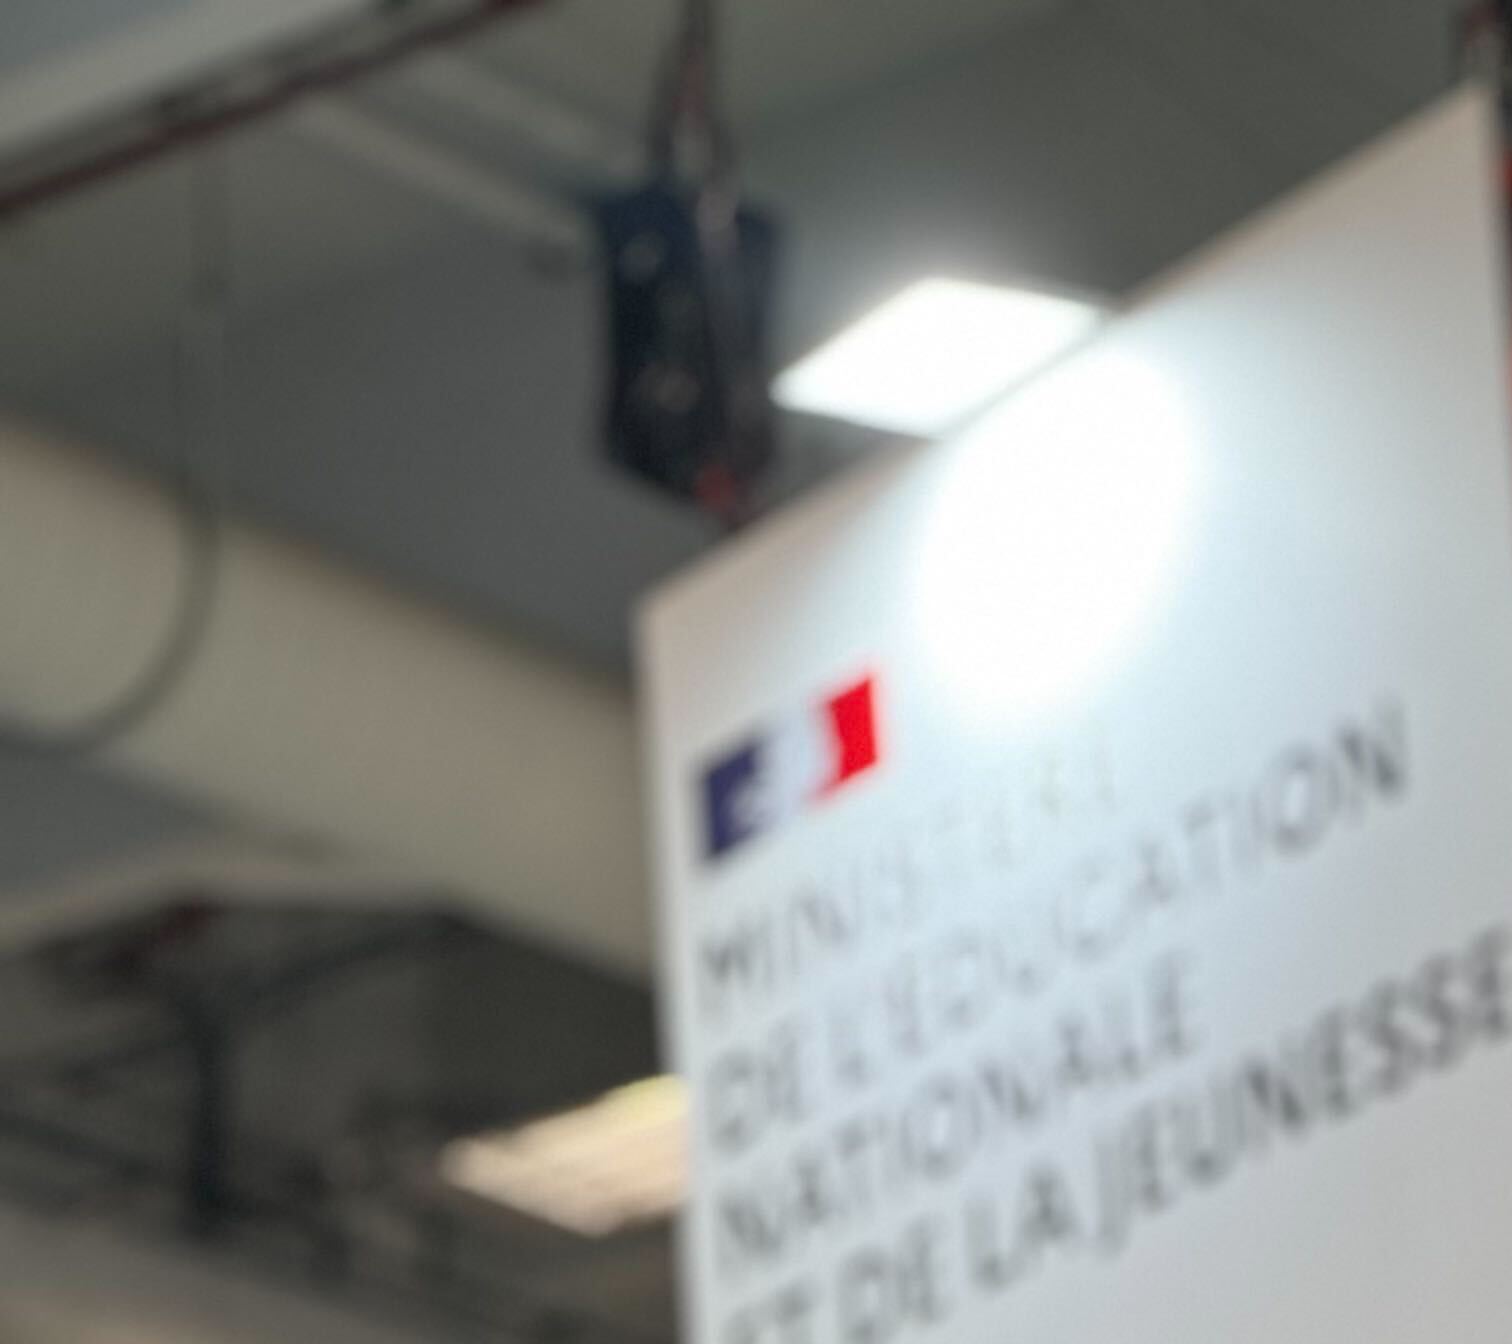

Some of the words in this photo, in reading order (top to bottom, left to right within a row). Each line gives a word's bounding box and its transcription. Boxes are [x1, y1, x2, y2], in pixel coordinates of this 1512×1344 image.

[706, 1026, 803, 1155] DE
[717, 949, 1199, 1272] NATIONALE
[965, 1160, 1080, 1294] LA
